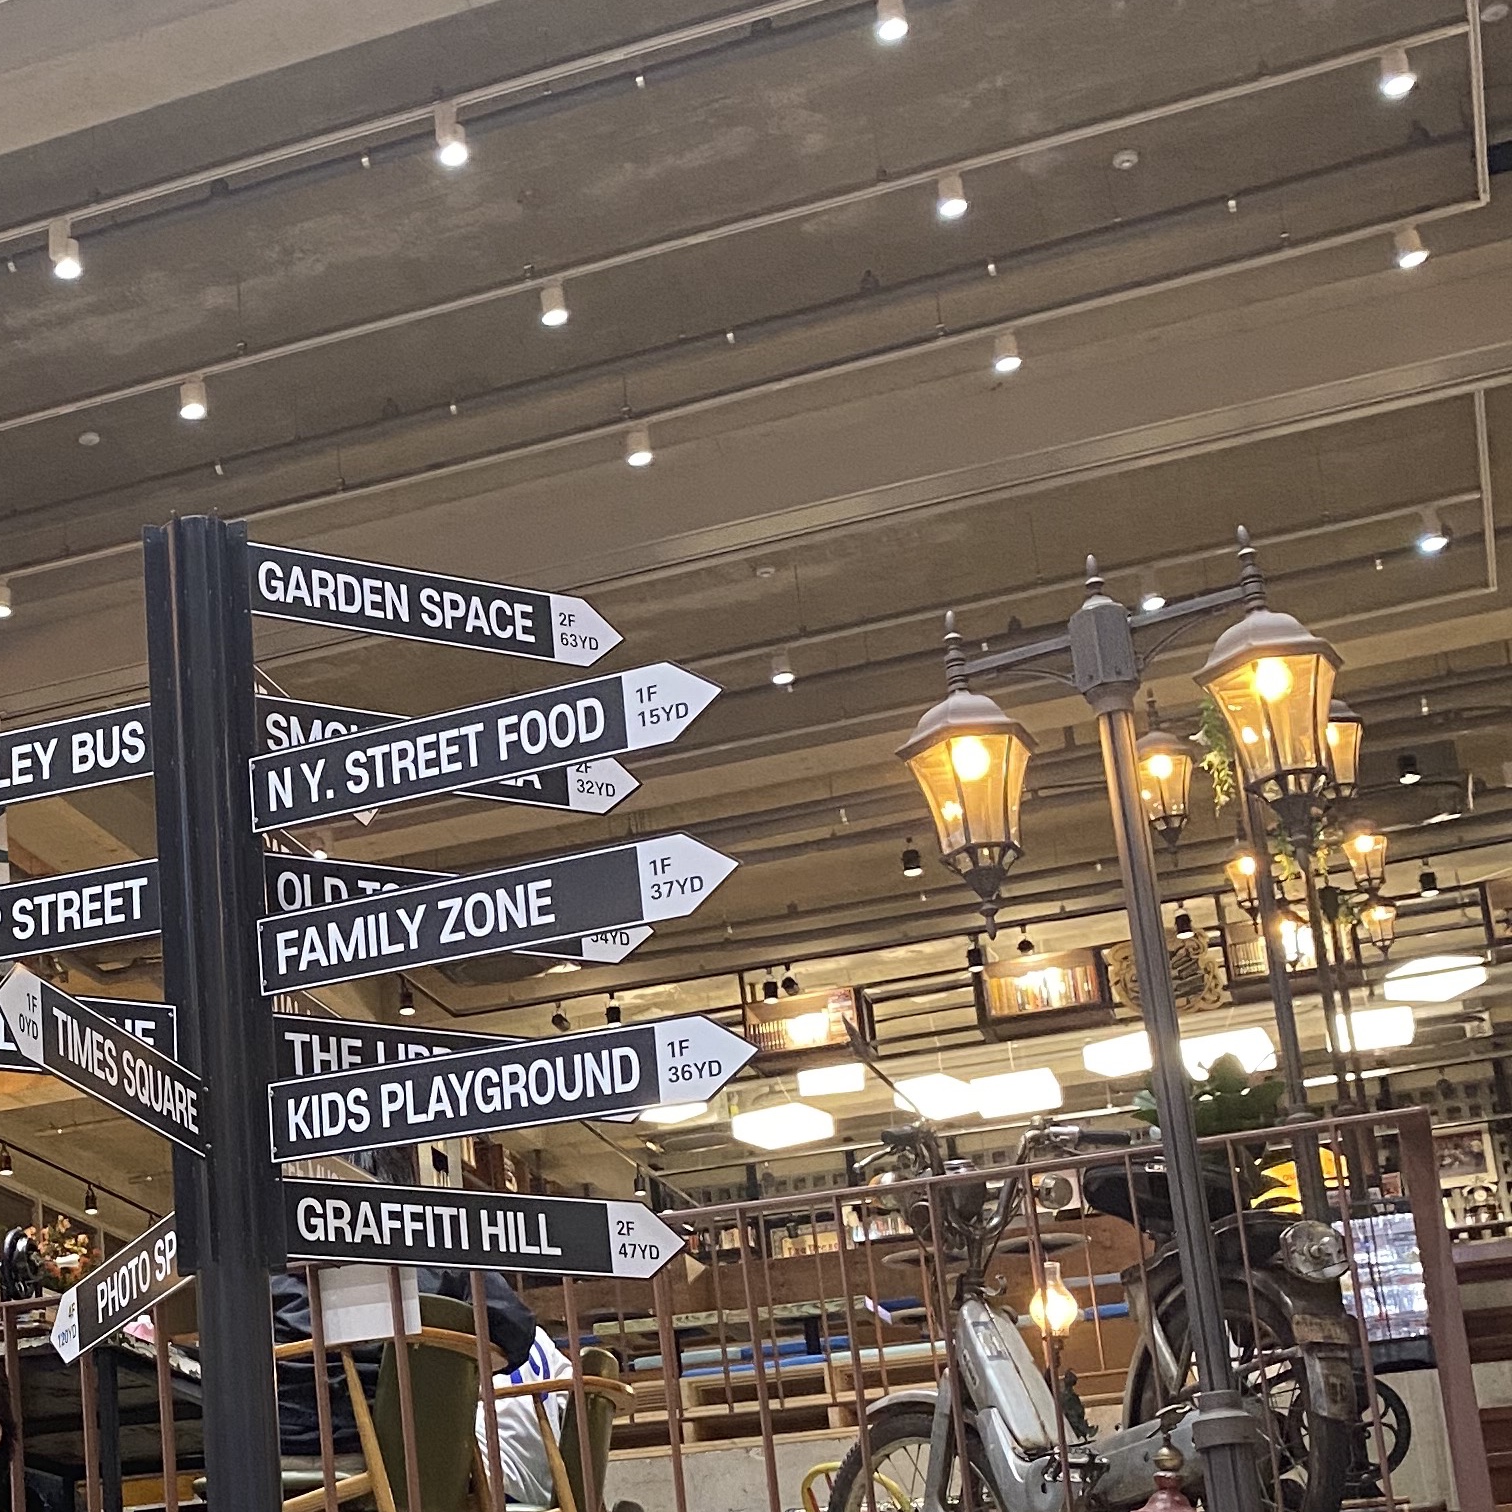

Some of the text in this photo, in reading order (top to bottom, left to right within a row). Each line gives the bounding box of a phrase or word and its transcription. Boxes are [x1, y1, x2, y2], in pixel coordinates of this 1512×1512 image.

[257, 560, 537, 643] GARDEN SPACE
[558, 611, 577, 628] 2F
[559, 632, 600, 652] 63YD
[635, 683, 659, 704] 1F
[637, 701, 690, 728] 15YD
[70, 720, 147, 775] BUS
[345, 722, 485, 794] STREET
[497, 697, 606, 761] FOOD
[575, 778, 617, 799] 32YD
[648, 857, 673, 876] 1F
[650, 875, 705, 901] 37YD
[11, 877, 149, 941] STREET
[275, 878, 556, 975] FAMILY ZONE
[26, 992, 39, 1014] 1F
[283, 1030, 363, 1077] THE
[666, 1038, 691, 1059] 1F
[52, 1006, 200, 1135] TIMES SQUARE
[667, 1058, 723, 1085] 36YD
[287, 1045, 641, 1143] KIDS PLAYGROUND
[295, 1196, 562, 1257] GRAFFITI HILL
[615, 1220, 635, 1238] 2F
[617, 1242, 660, 1262] 47YD
[96, 1250, 151, 1324] PHOTO
